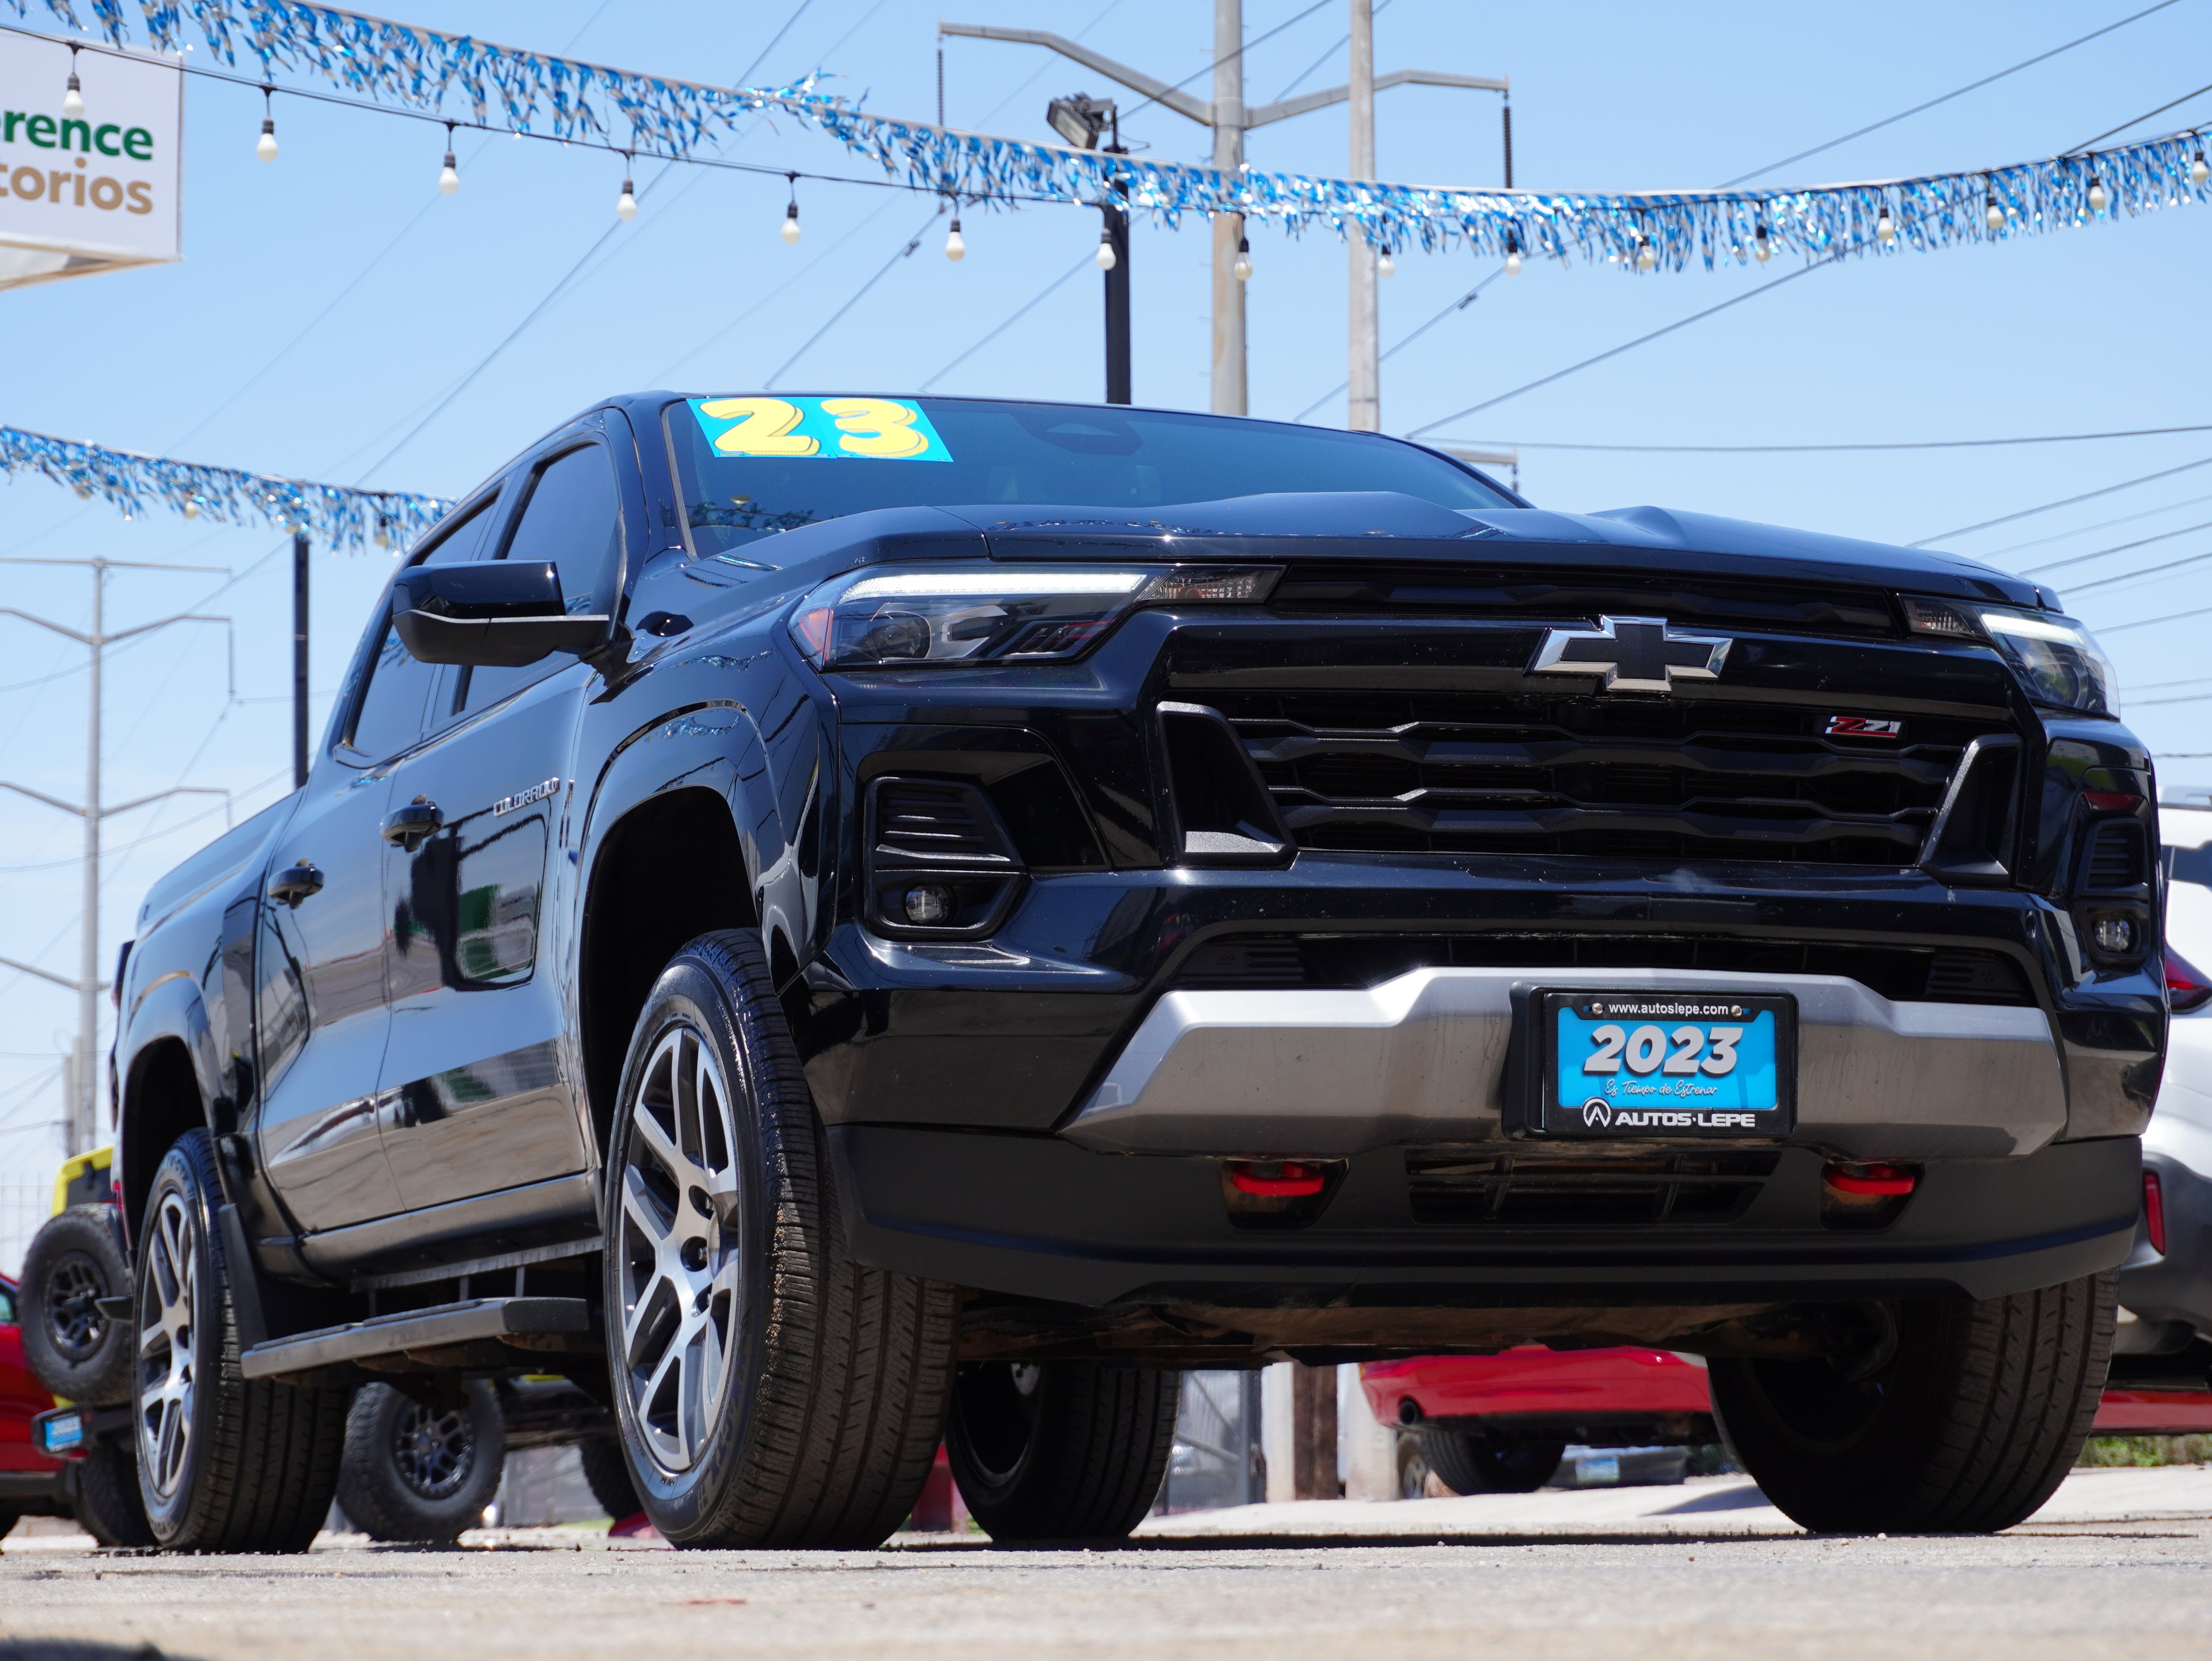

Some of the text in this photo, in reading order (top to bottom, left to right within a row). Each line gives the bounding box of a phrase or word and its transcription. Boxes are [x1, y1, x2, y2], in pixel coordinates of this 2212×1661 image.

[0, 110, 153, 161] rence
[1825, 716, 1902, 738] Z71
[1608, 1002, 1729, 1016] www.autoslepe.com
[1583, 1024, 1744, 1075] 2023
[1605, 1079, 1718, 1098] Es Tiempo de Estrenar
